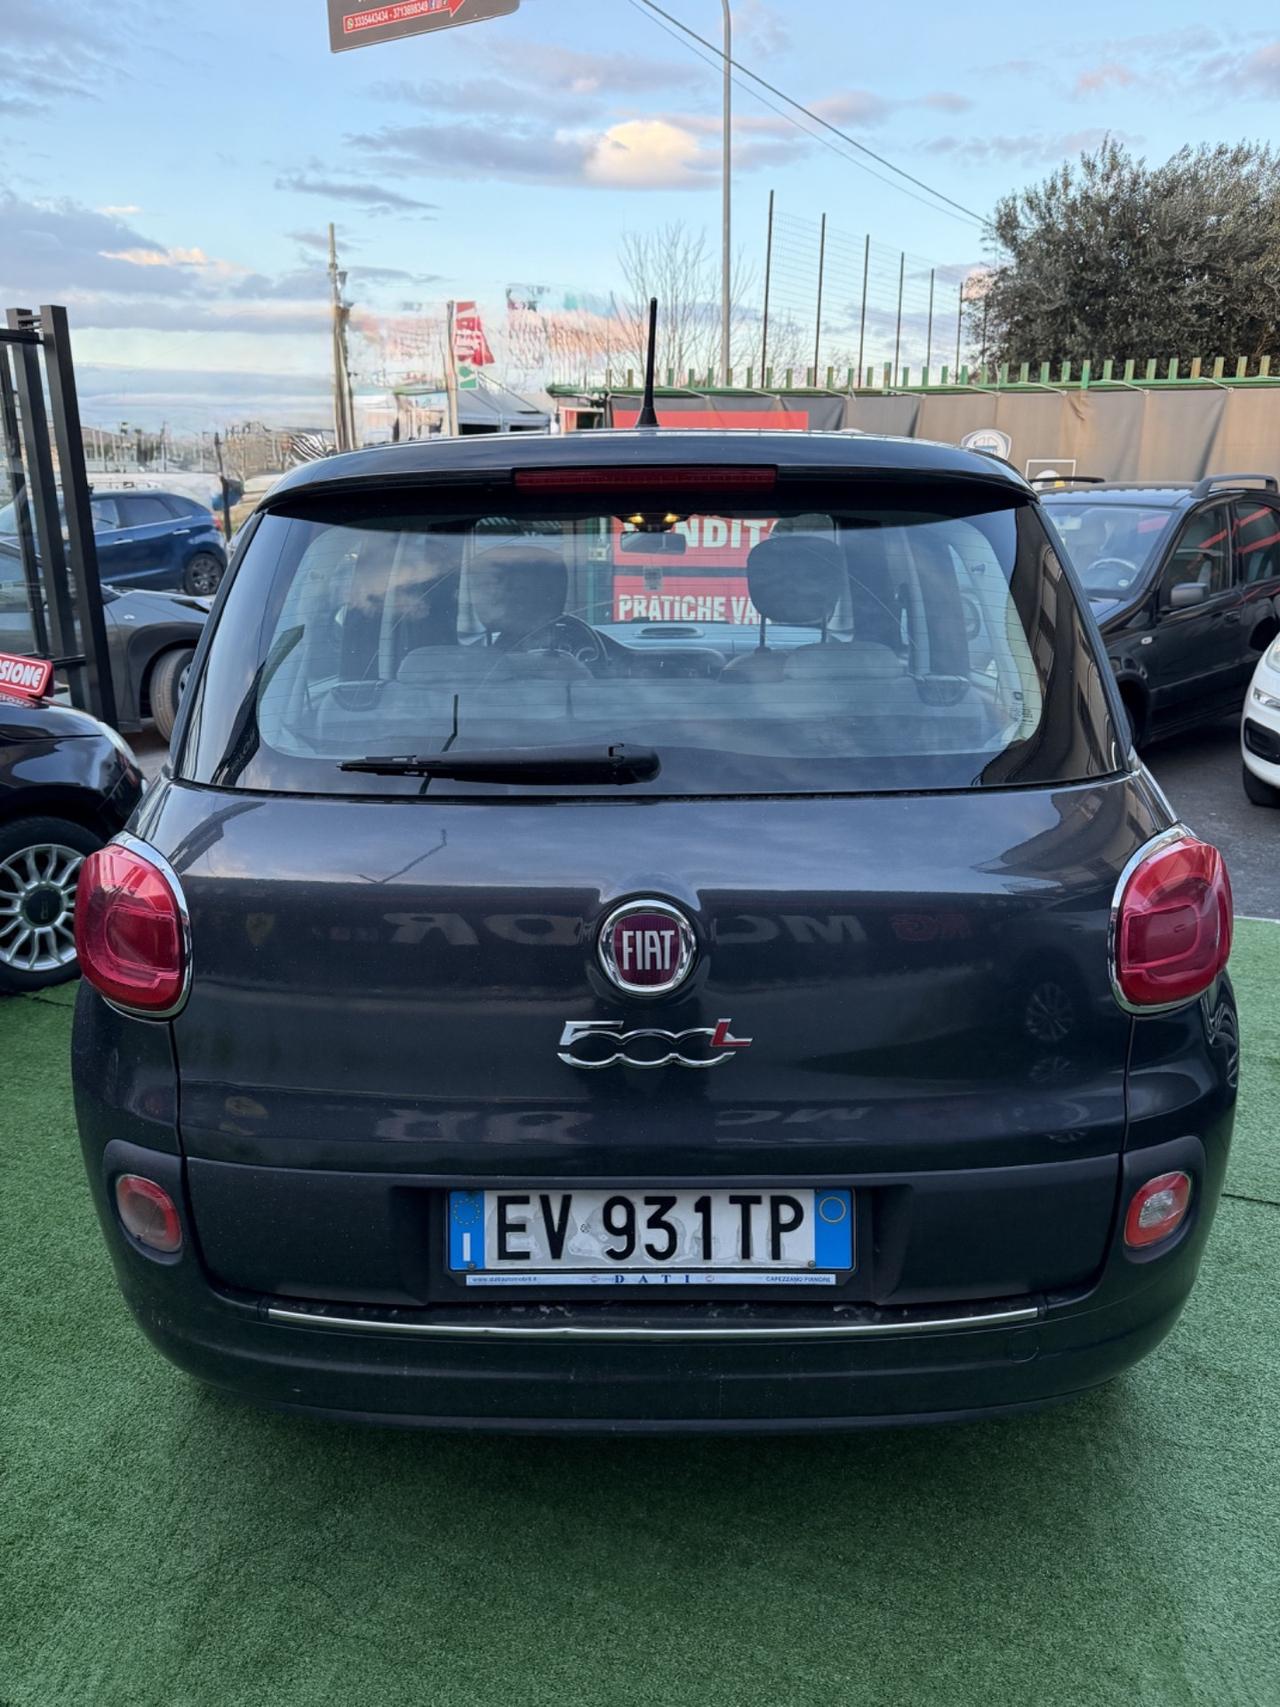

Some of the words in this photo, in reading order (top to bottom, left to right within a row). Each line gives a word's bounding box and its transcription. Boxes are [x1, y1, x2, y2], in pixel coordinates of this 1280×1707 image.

[618, 594, 727, 621] PRATICHE
[622, 929, 675, 970] FIAT
[557, 1018, 753, 1069] 500L
[497, 1194, 572, 1260] EV
